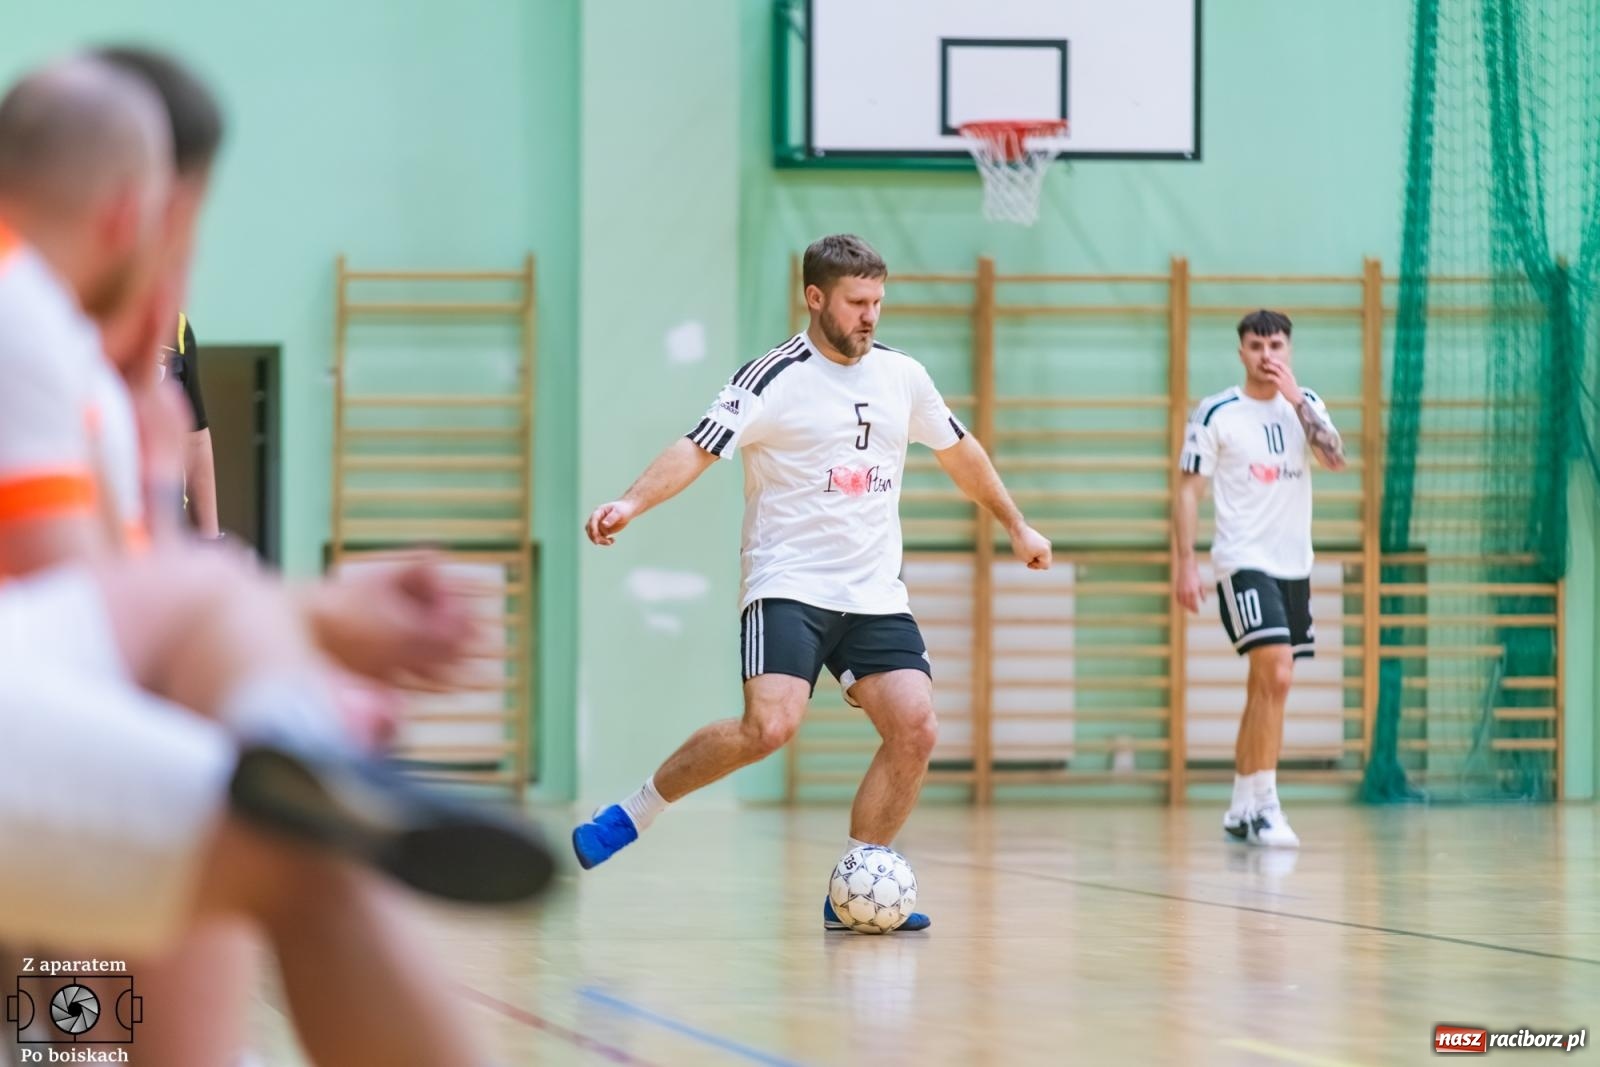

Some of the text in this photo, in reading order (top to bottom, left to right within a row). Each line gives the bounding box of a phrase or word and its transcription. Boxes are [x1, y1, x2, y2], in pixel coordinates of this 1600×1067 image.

[854, 403, 871, 450] 5
[1263, 422, 1284, 455] 10
[1236, 588, 1263, 631] 10
